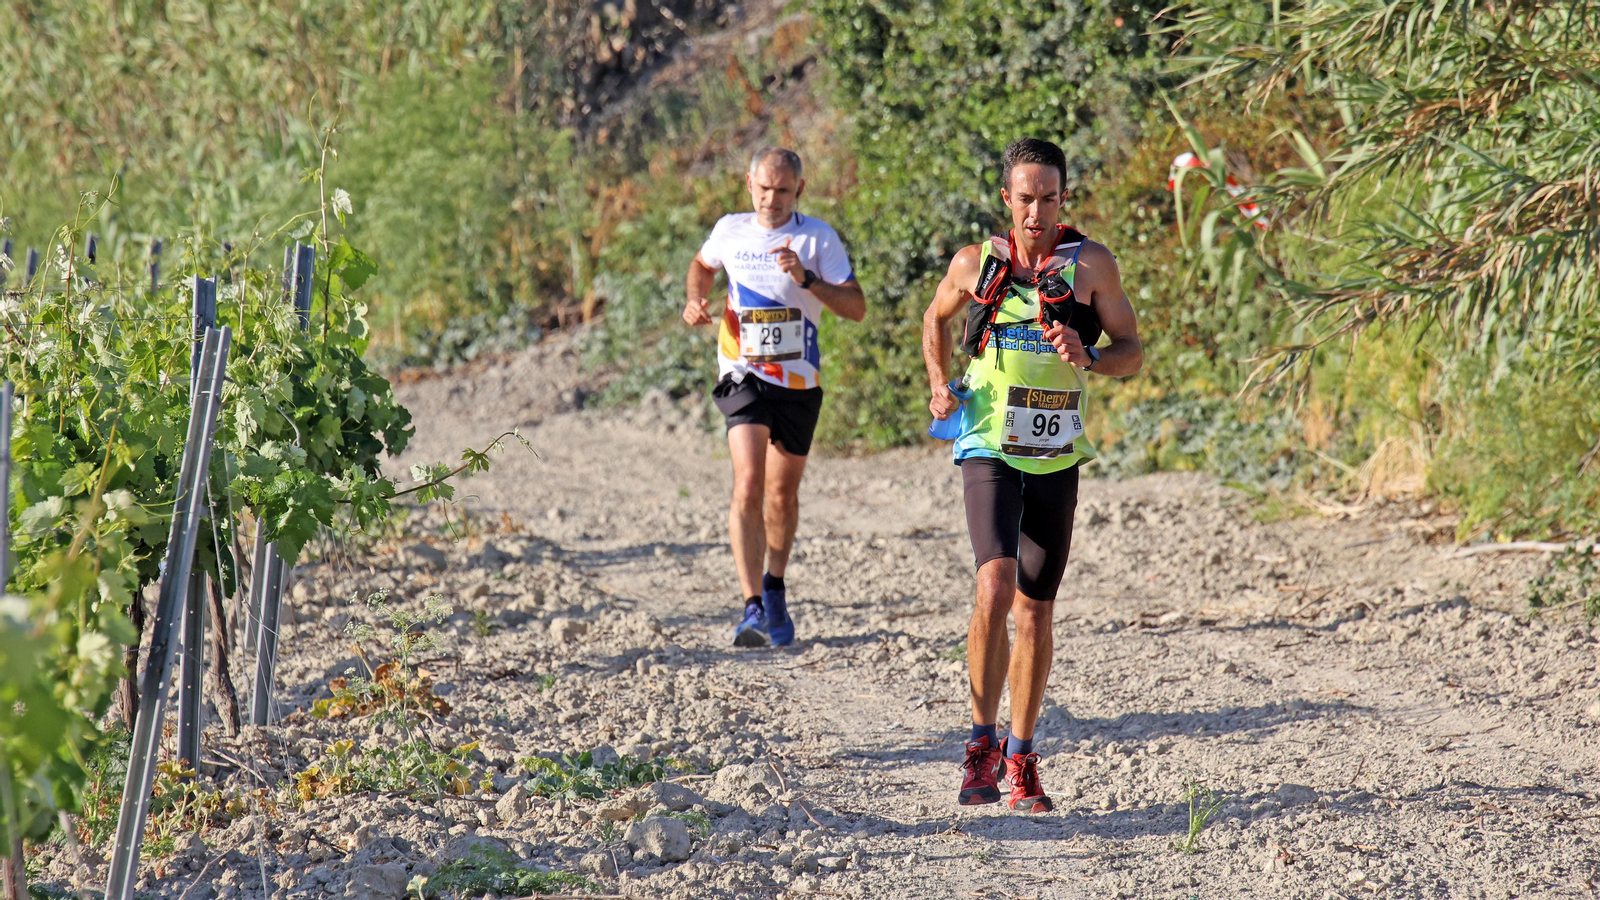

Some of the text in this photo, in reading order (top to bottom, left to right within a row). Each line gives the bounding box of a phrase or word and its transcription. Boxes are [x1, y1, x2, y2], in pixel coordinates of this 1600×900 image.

[761, 327, 782, 345] 29
[1021, 340, 1036, 352] de
[1031, 391, 1066, 404] Sherry
[1031, 413, 1061, 437] 96
